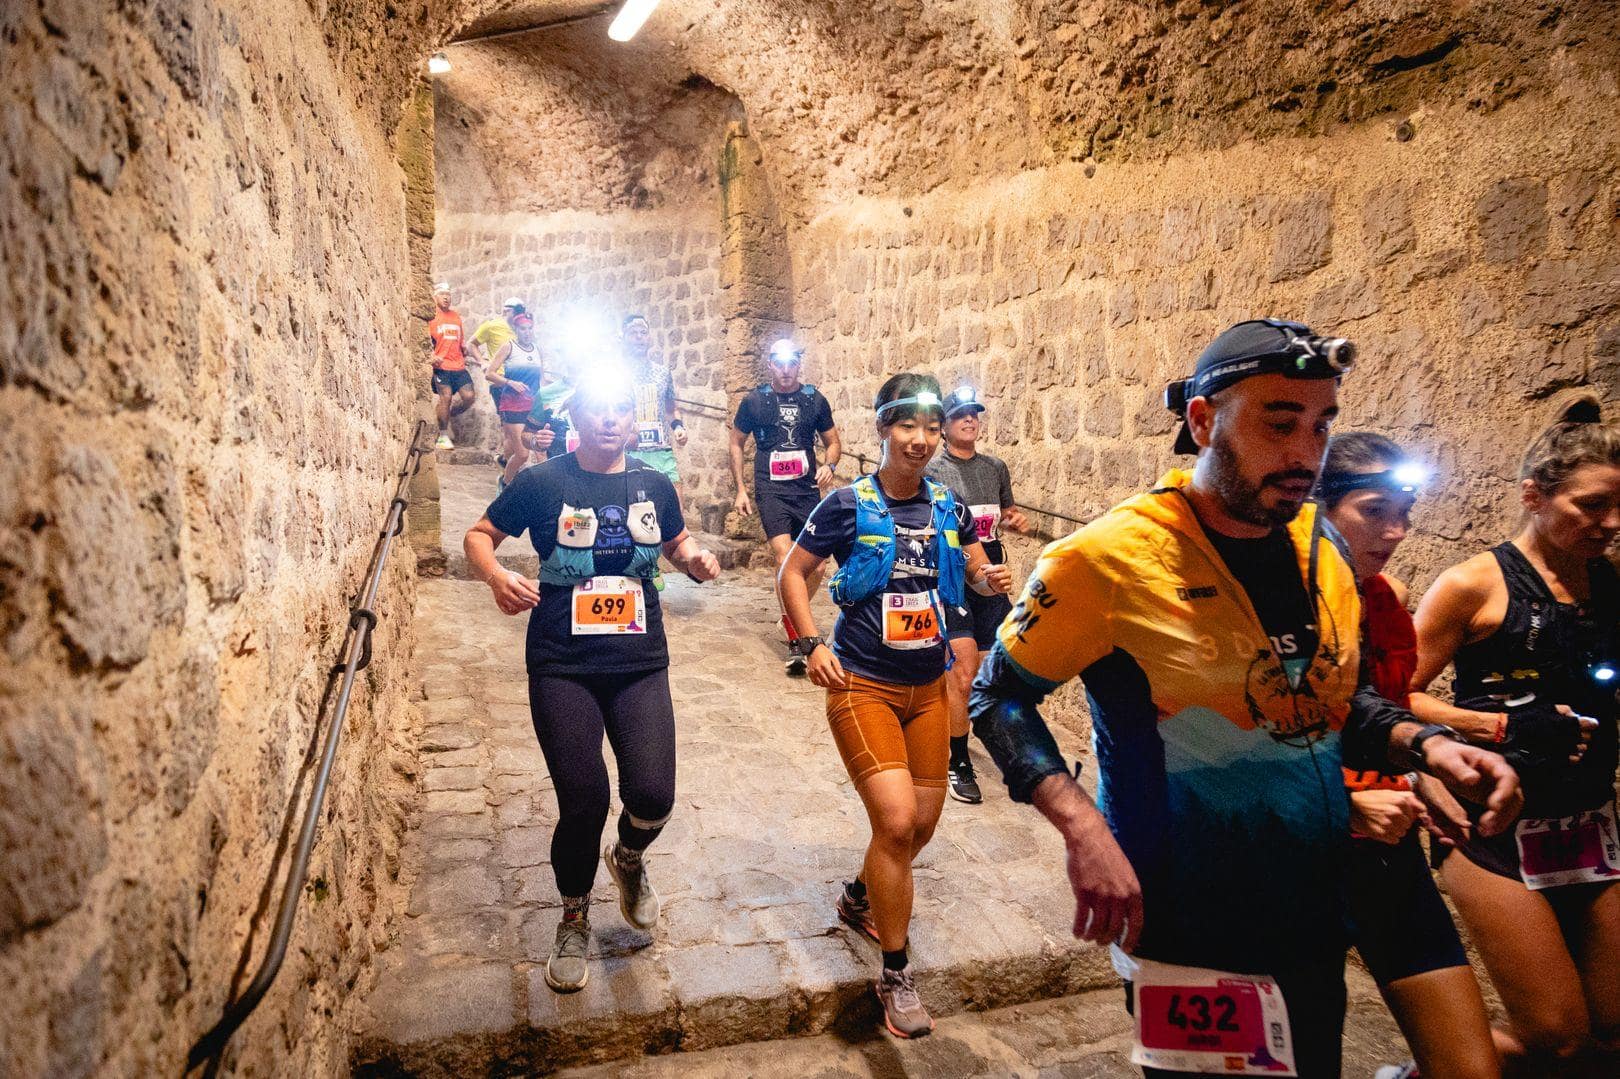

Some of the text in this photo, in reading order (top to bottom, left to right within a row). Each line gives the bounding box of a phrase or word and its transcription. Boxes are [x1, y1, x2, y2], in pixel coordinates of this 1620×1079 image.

[778, 462, 797, 472] 361
[591, 598, 626, 615] 699
[901, 612, 932, 632] 766
[1167, 994, 1240, 1033] 432
